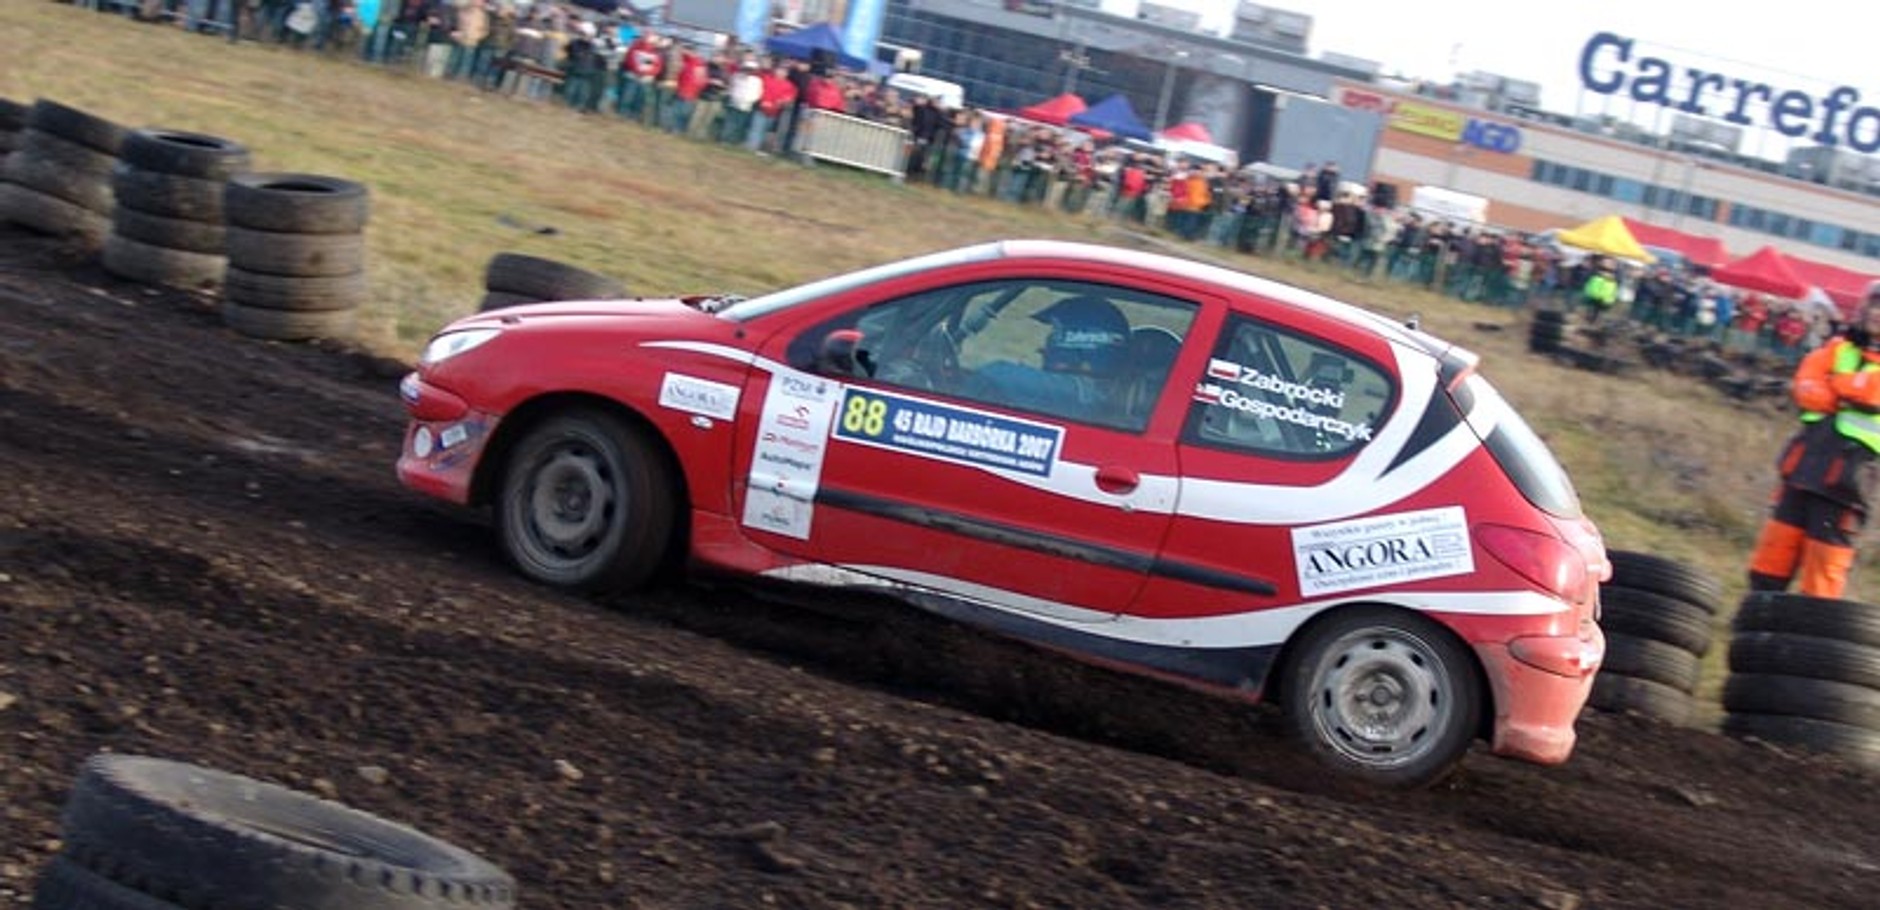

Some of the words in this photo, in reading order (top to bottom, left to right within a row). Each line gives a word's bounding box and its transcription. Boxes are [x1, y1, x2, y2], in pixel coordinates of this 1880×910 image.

[1240, 366, 1345, 408] Zabrocki
[844, 395, 887, 437] 88
[893, 409, 914, 433] 45
[1018, 433, 1054, 460] 2007
[1219, 389, 1373, 441] Gospodarczyk
[1305, 537, 1432, 574] ANGORA
